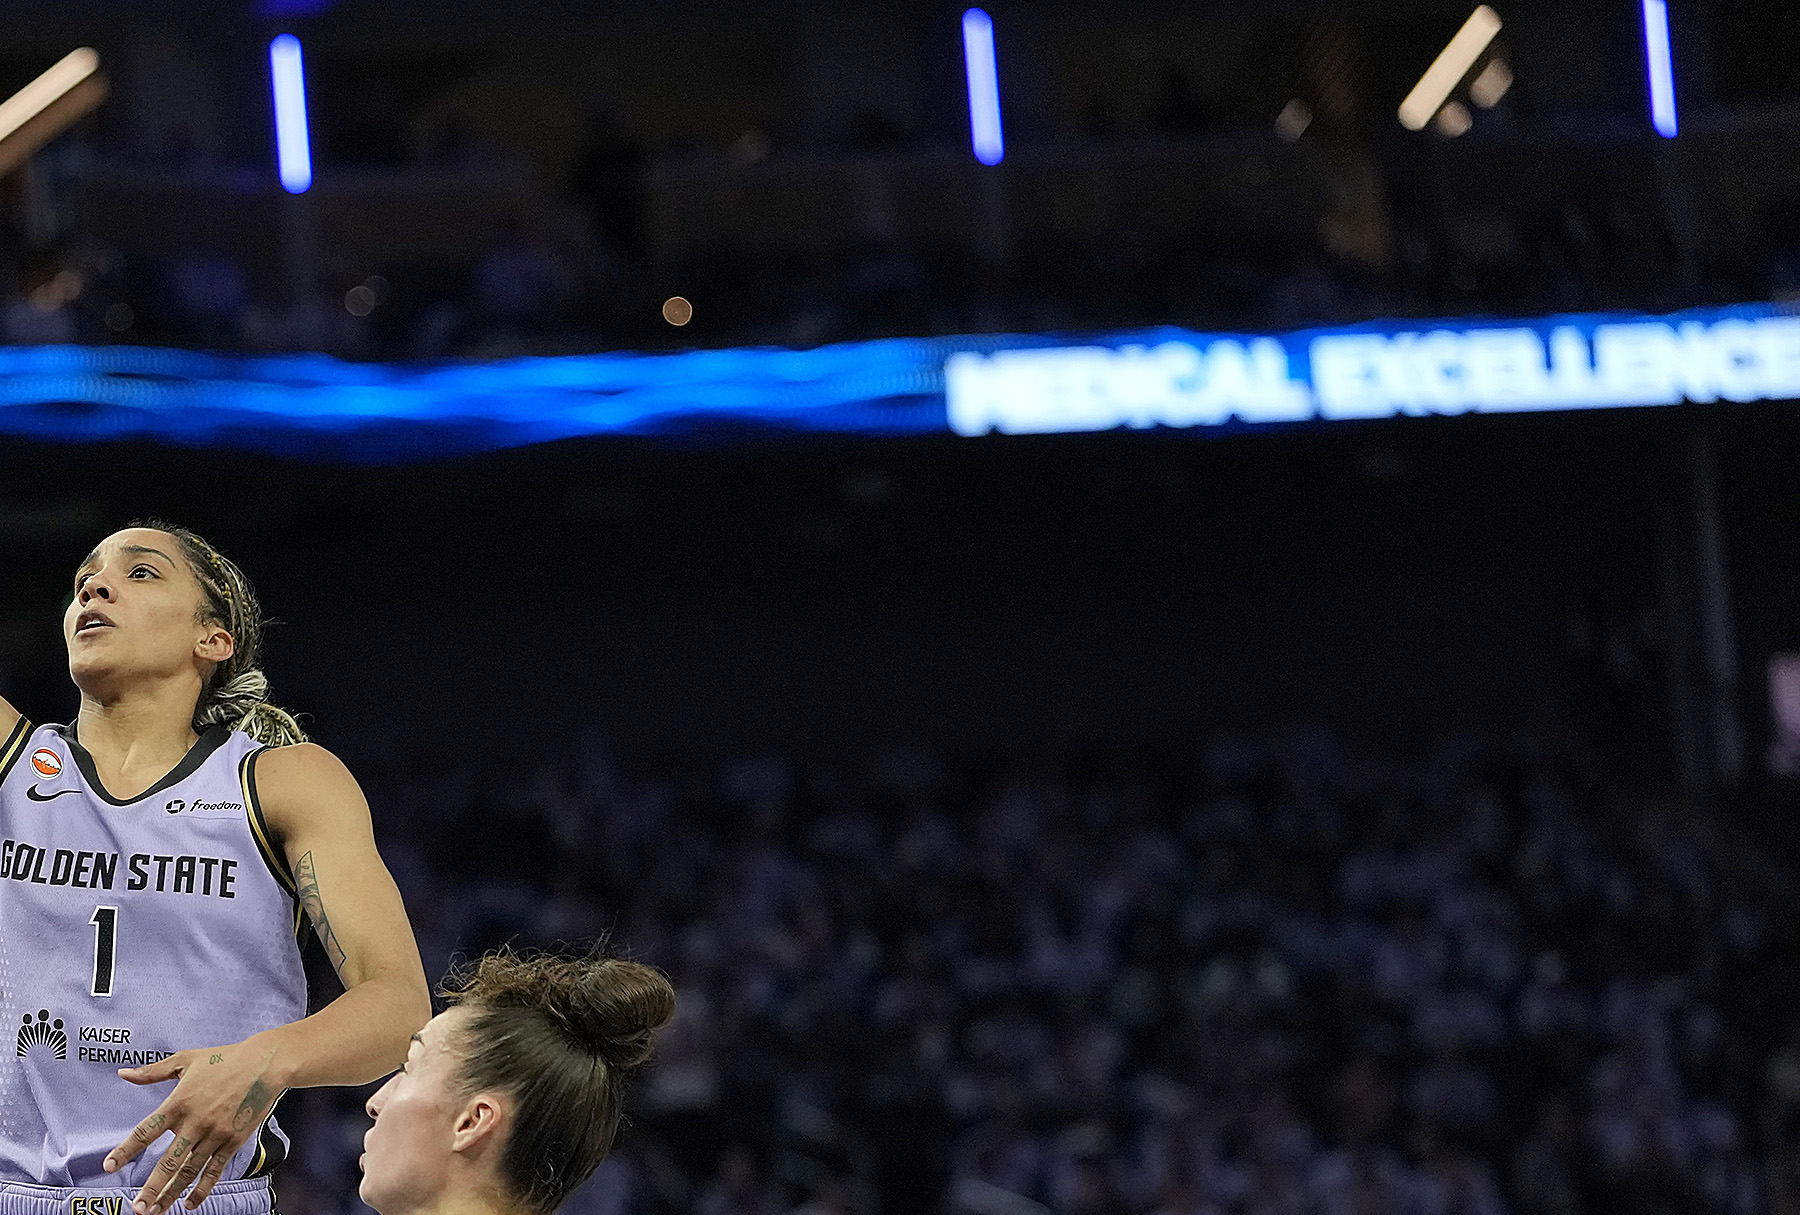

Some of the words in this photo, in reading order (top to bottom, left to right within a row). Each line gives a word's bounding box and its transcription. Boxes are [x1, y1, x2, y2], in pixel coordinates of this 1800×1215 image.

[946, 336, 1314, 437] MEDICAL
[1309, 316, 1800, 421] EXCELLENCE
[189, 798, 243, 813] freedom
[0, 839, 119, 891] GOLDEN
[126, 852, 239, 899] STATE
[88, 904, 119, 997] 1
[78, 1026, 131, 1044] KAISER
[78, 1046, 176, 1066] PERMANEN
